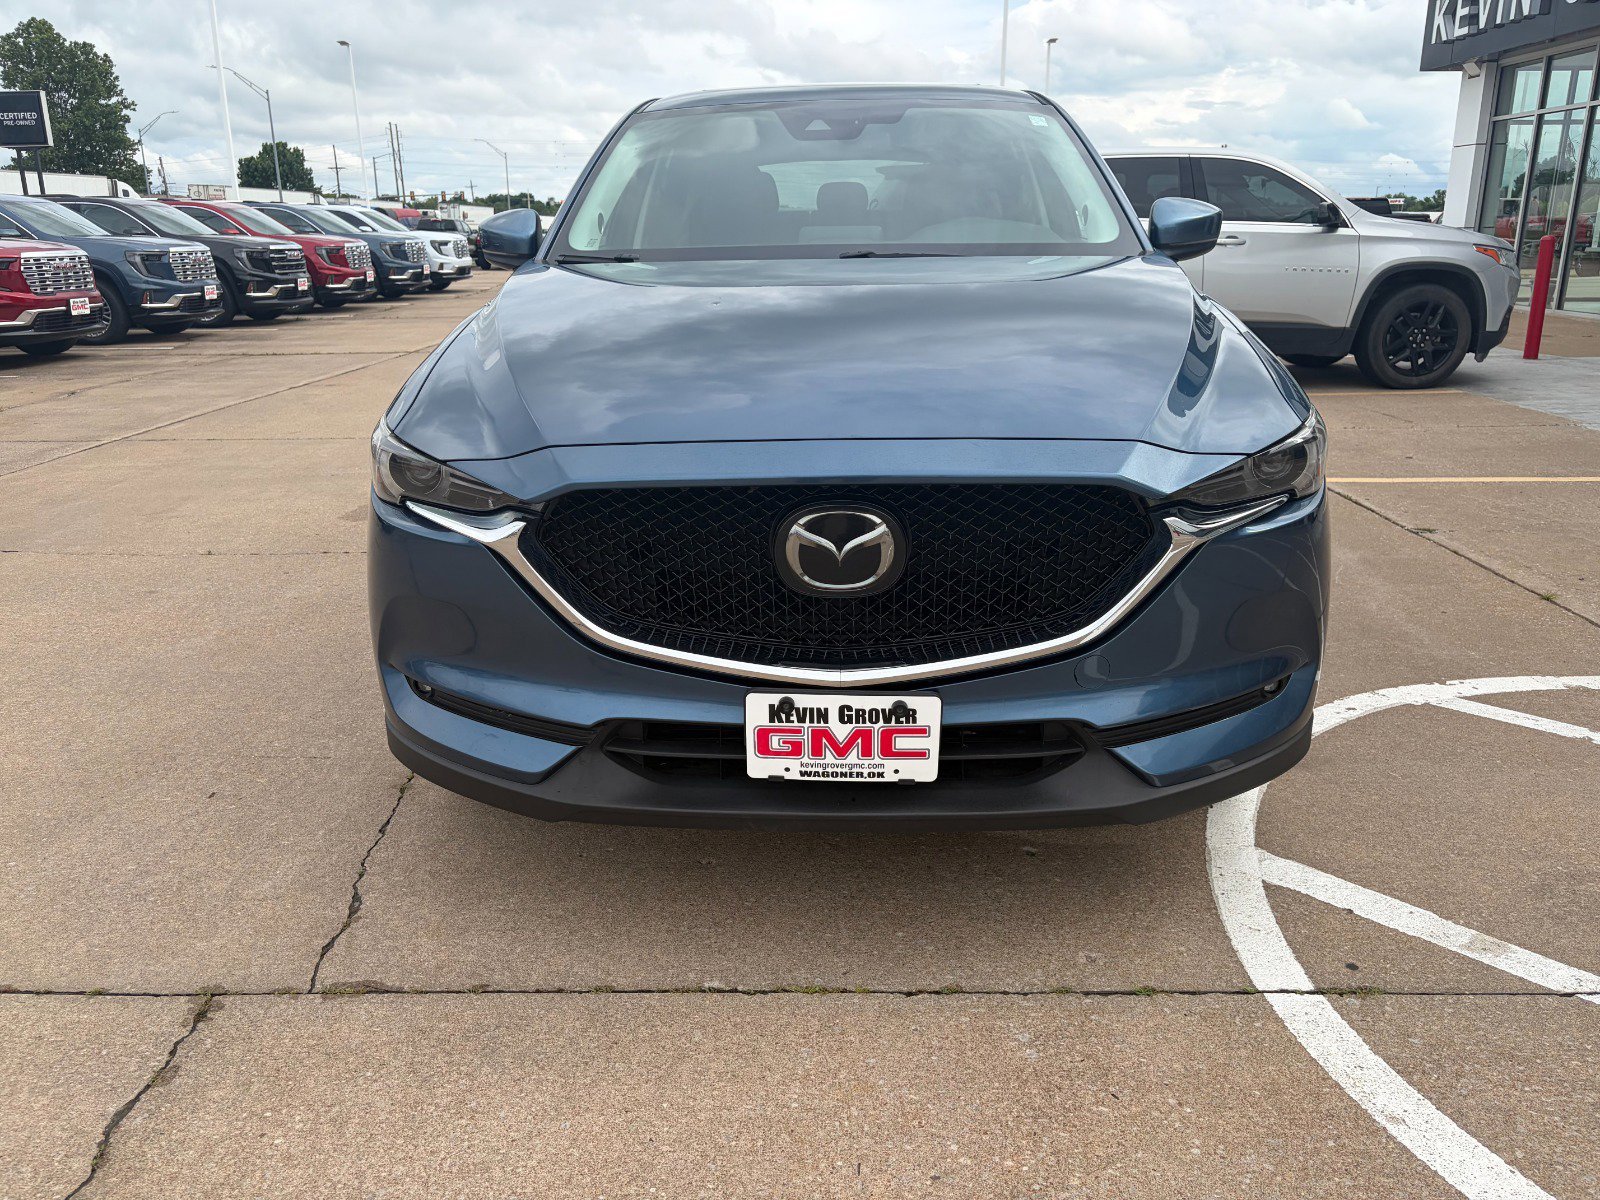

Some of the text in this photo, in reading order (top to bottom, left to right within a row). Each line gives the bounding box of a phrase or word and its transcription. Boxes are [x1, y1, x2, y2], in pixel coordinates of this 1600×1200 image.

[0, 112, 38, 120] CERTIFIED
[768, 703, 829, 724] KEVIN
[753, 725, 931, 760] GMC
[799, 761, 886, 771] kevingrovergmc.com
